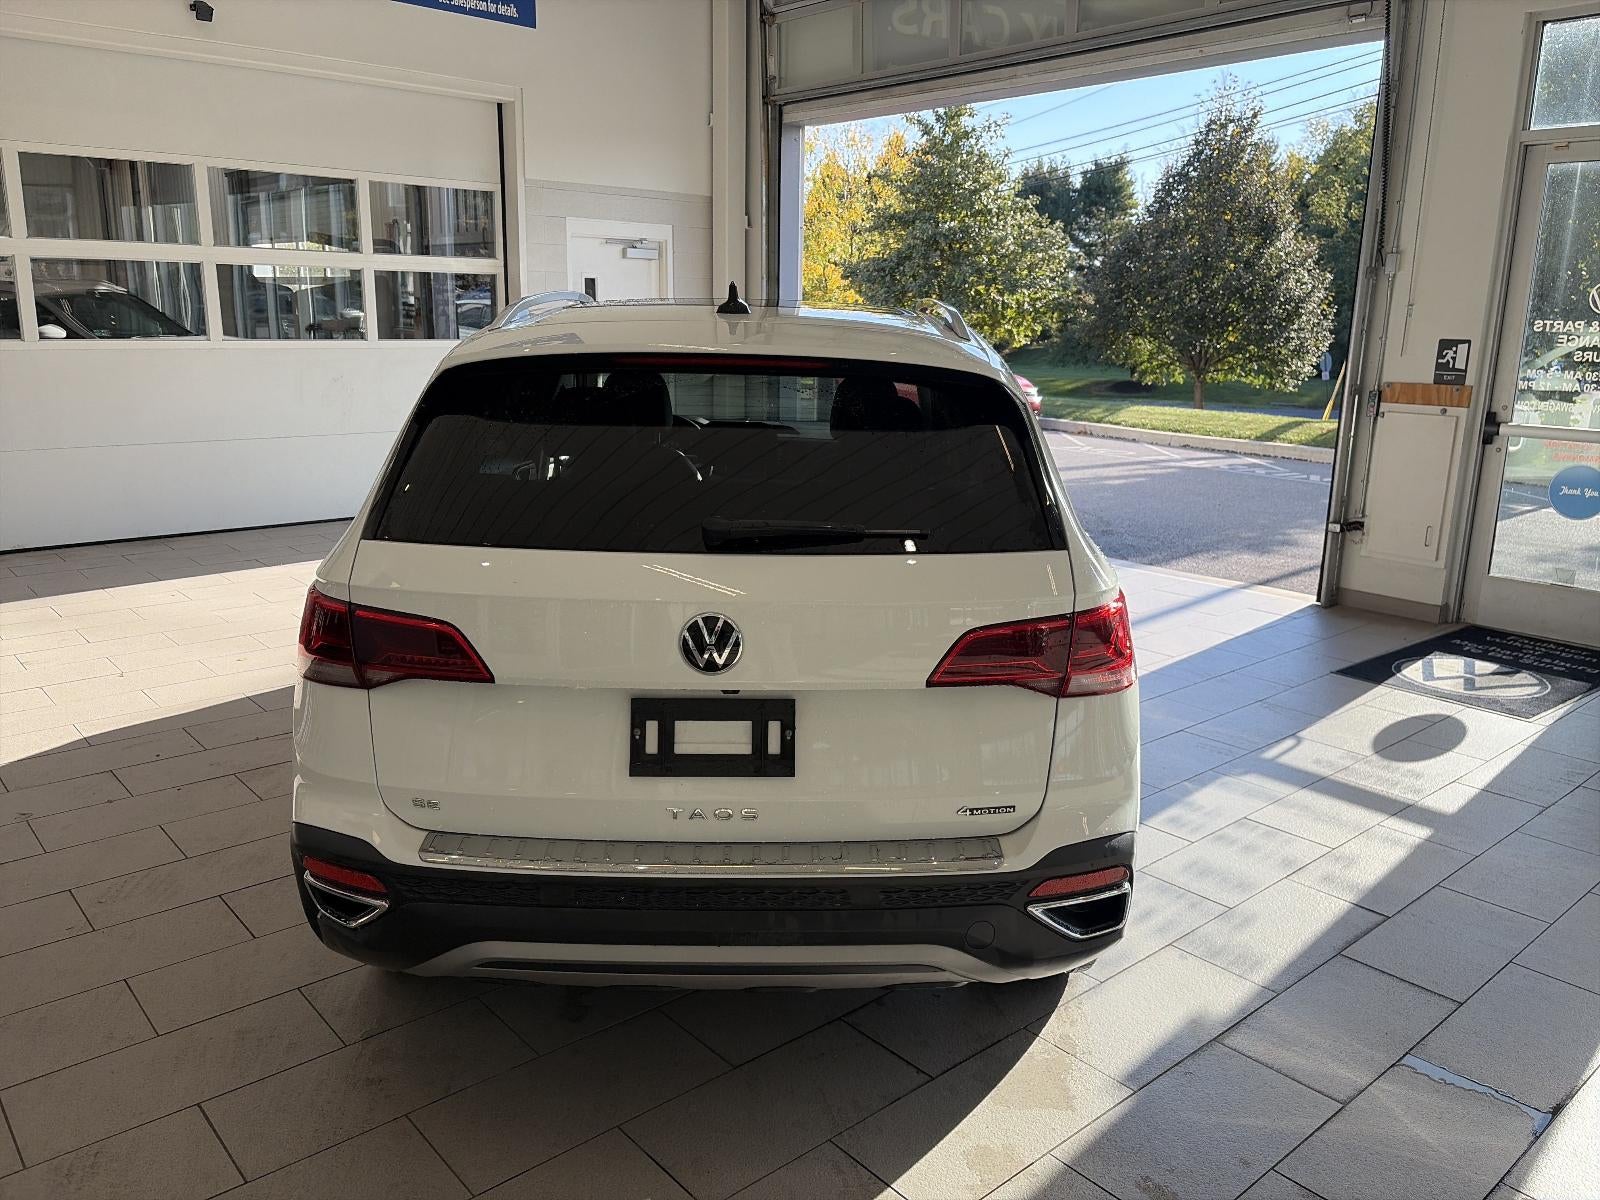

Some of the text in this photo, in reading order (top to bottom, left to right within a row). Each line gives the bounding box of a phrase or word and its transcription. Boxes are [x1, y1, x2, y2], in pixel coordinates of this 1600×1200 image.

[488, 2, 497, 13] for
[1559, 485, 1600, 498] Thank You
[412, 797, 440, 810] SE
[665, 807, 760, 821] TAOS
